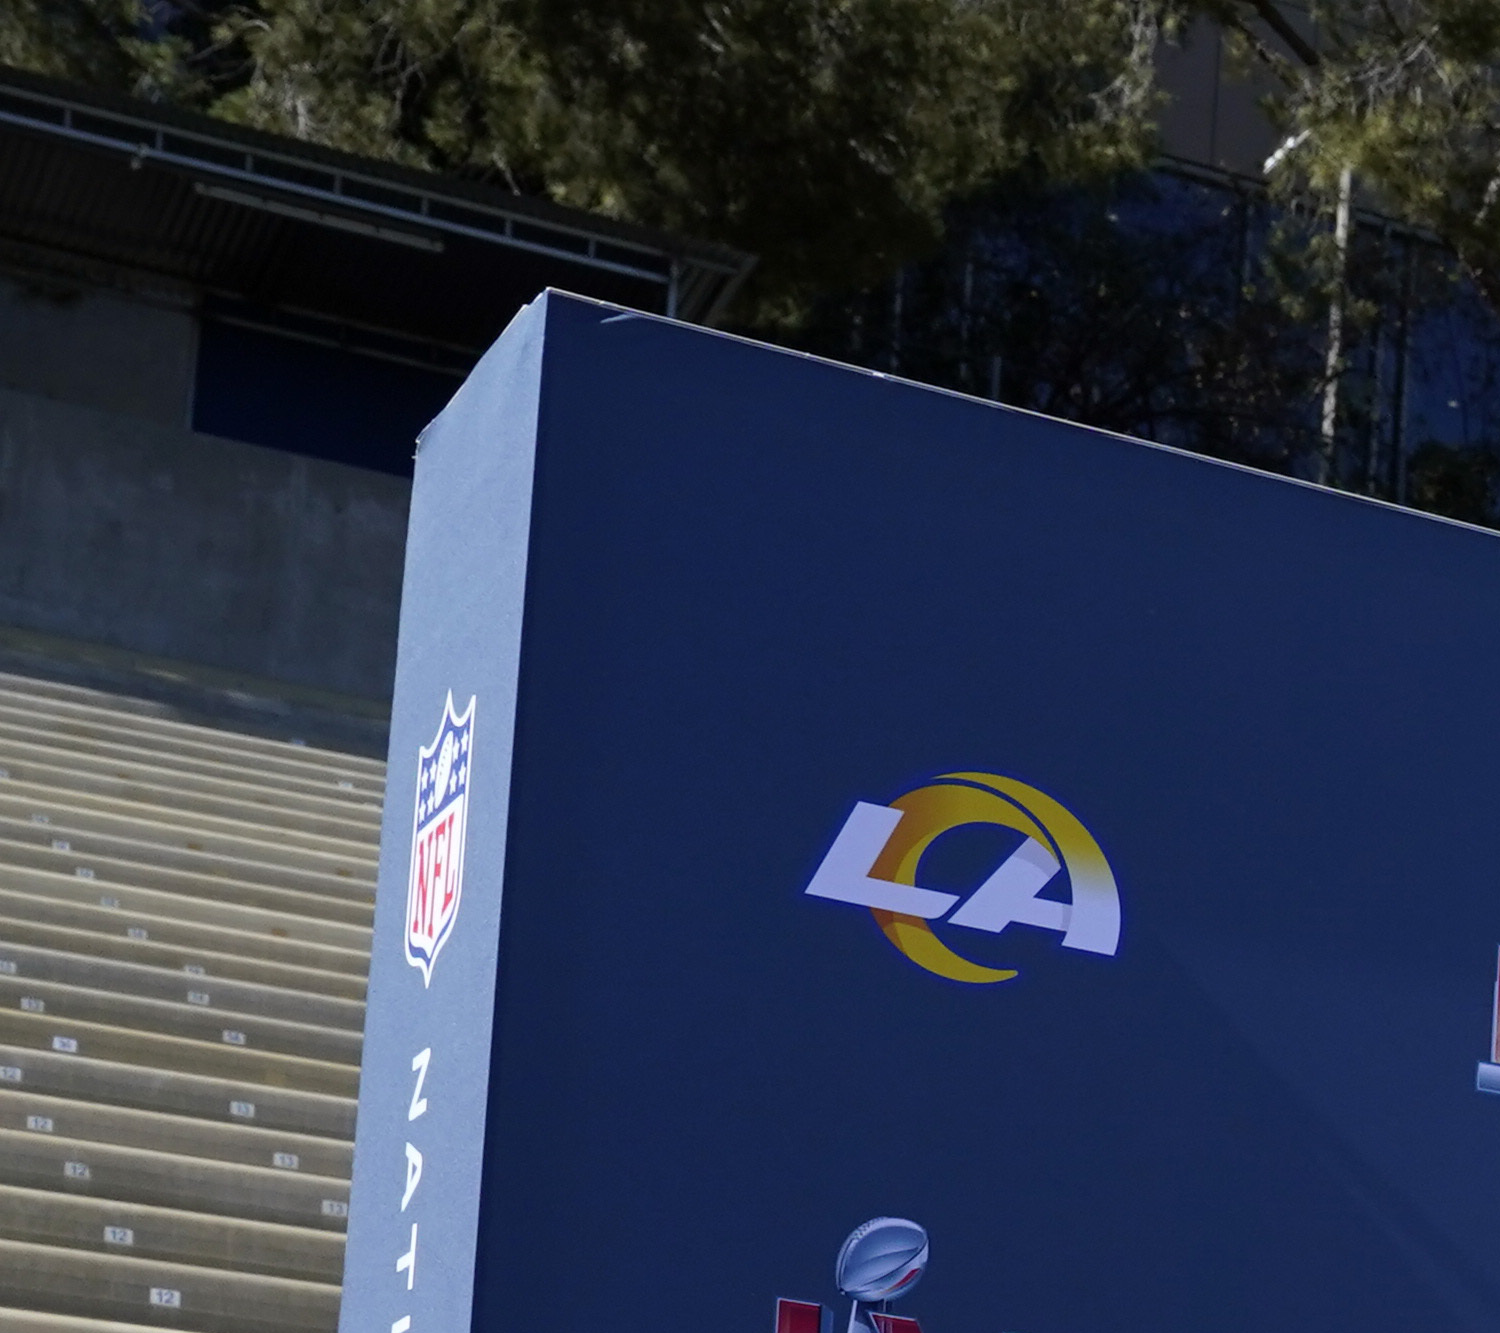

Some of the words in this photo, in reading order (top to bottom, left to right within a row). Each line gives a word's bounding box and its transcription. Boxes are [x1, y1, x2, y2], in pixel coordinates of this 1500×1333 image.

[804, 771, 1120, 956] LA
[412, 811, 456, 938] NFL
[72, 1164, 86, 1177] 12
[111, 1228, 127, 1243] 12
[157, 1290, 174, 1305] 12
